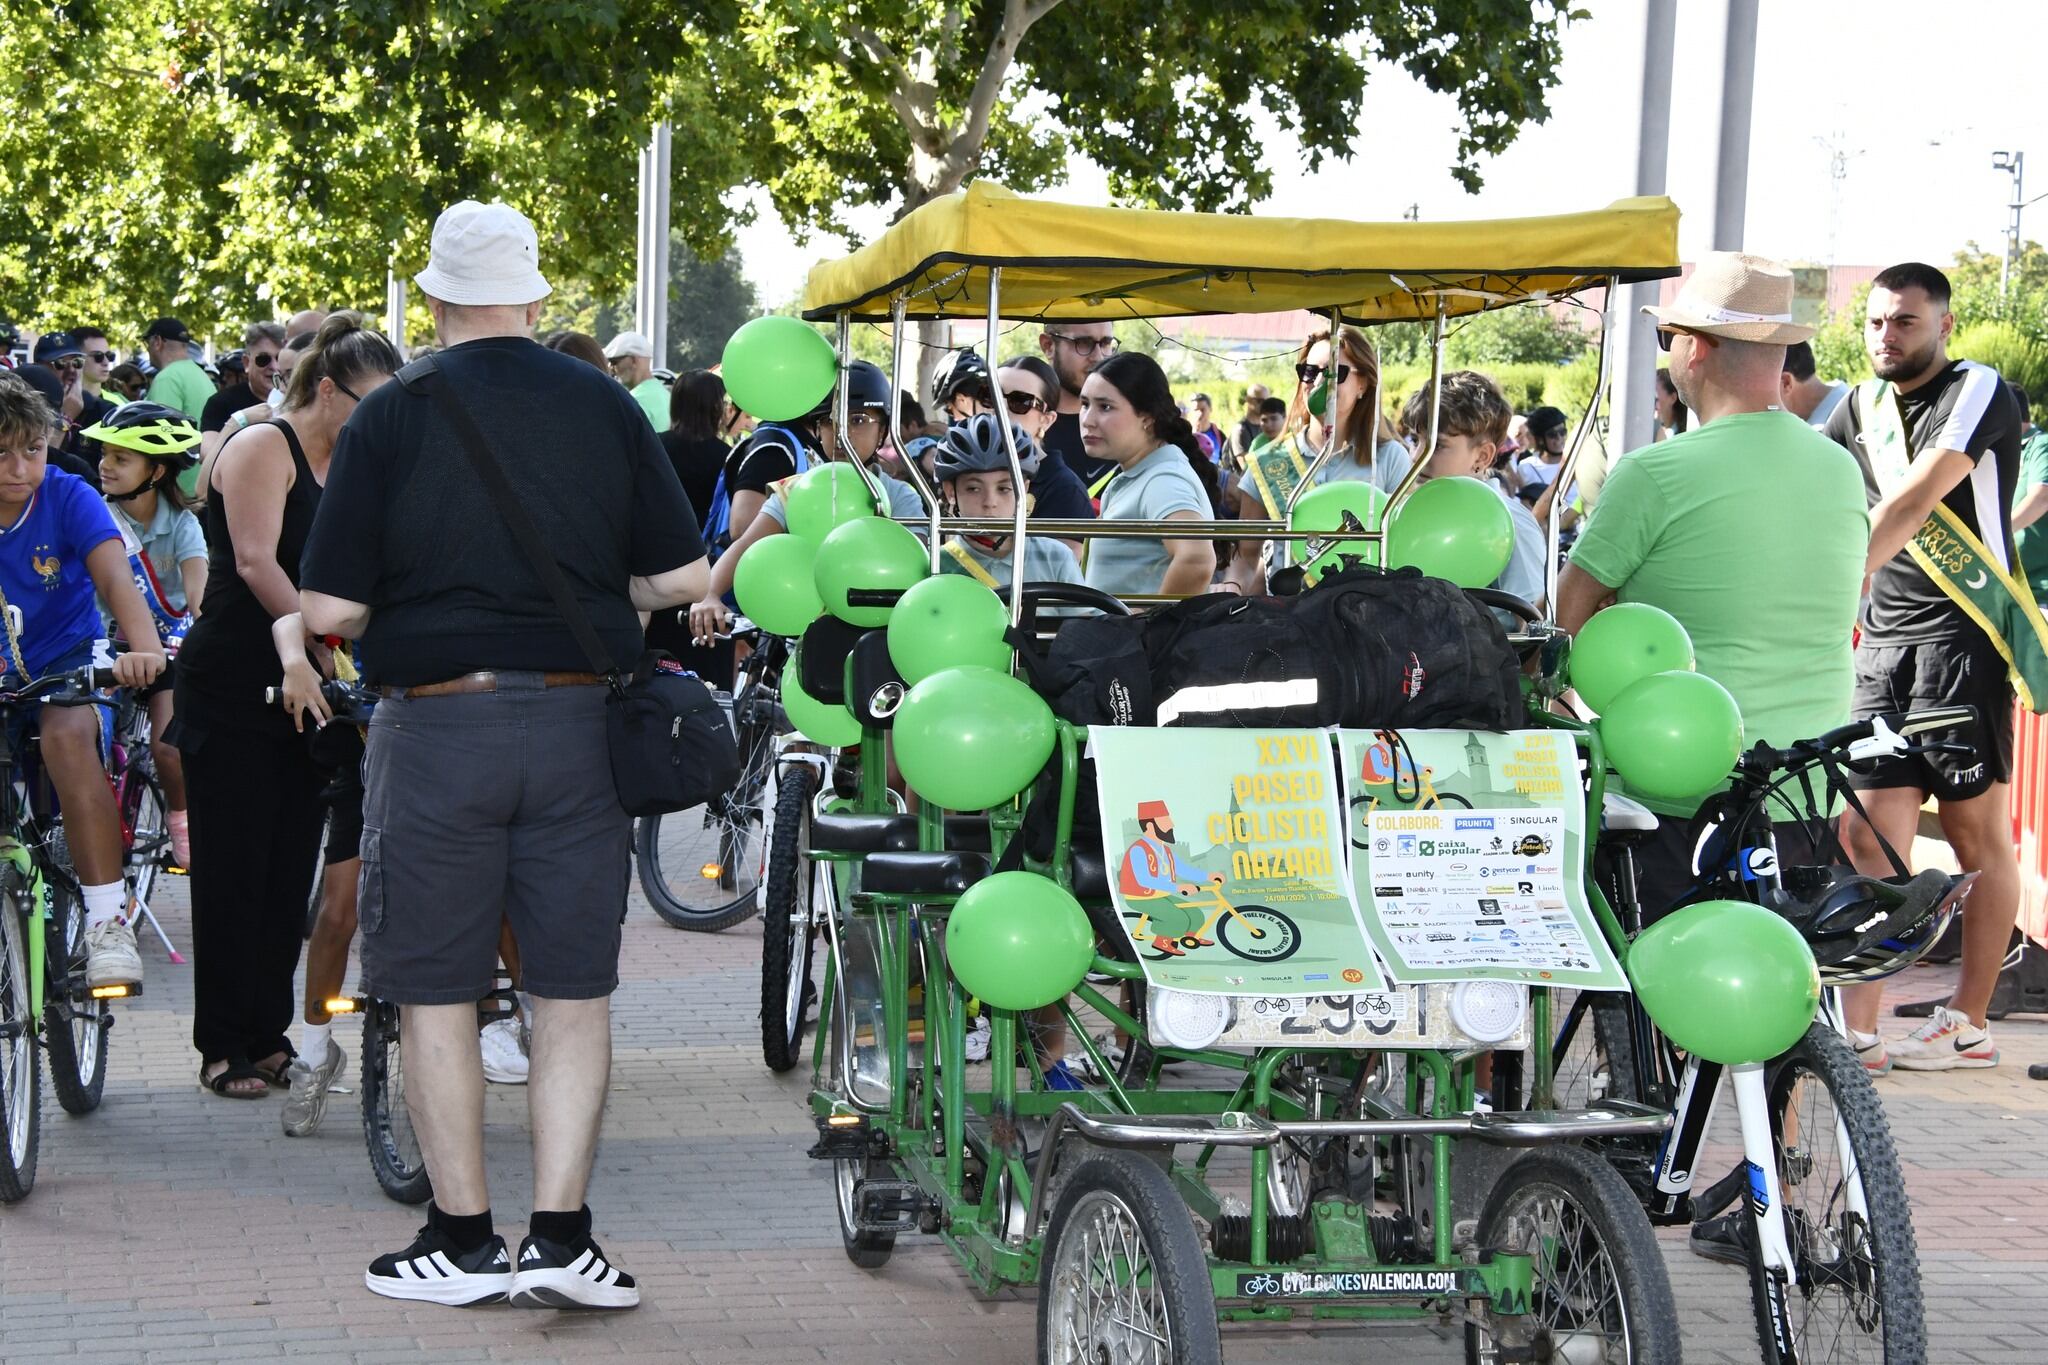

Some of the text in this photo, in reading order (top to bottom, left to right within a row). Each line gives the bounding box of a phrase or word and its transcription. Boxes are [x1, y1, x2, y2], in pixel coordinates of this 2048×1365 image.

[1256, 736, 1319, 765] XXVI
[1234, 770, 1323, 805] PASEO
[1207, 808, 1327, 845] CICLISTA
[1376, 816, 1558, 831] COLABORA: PRUNITA SINGULAR
[1438, 846, 1481, 856] popular
[1412, 870, 1435, 880] unity
[1662, 1154, 1672, 1174] GIANT
[1766, 1271, 1786, 1354] GIANT
